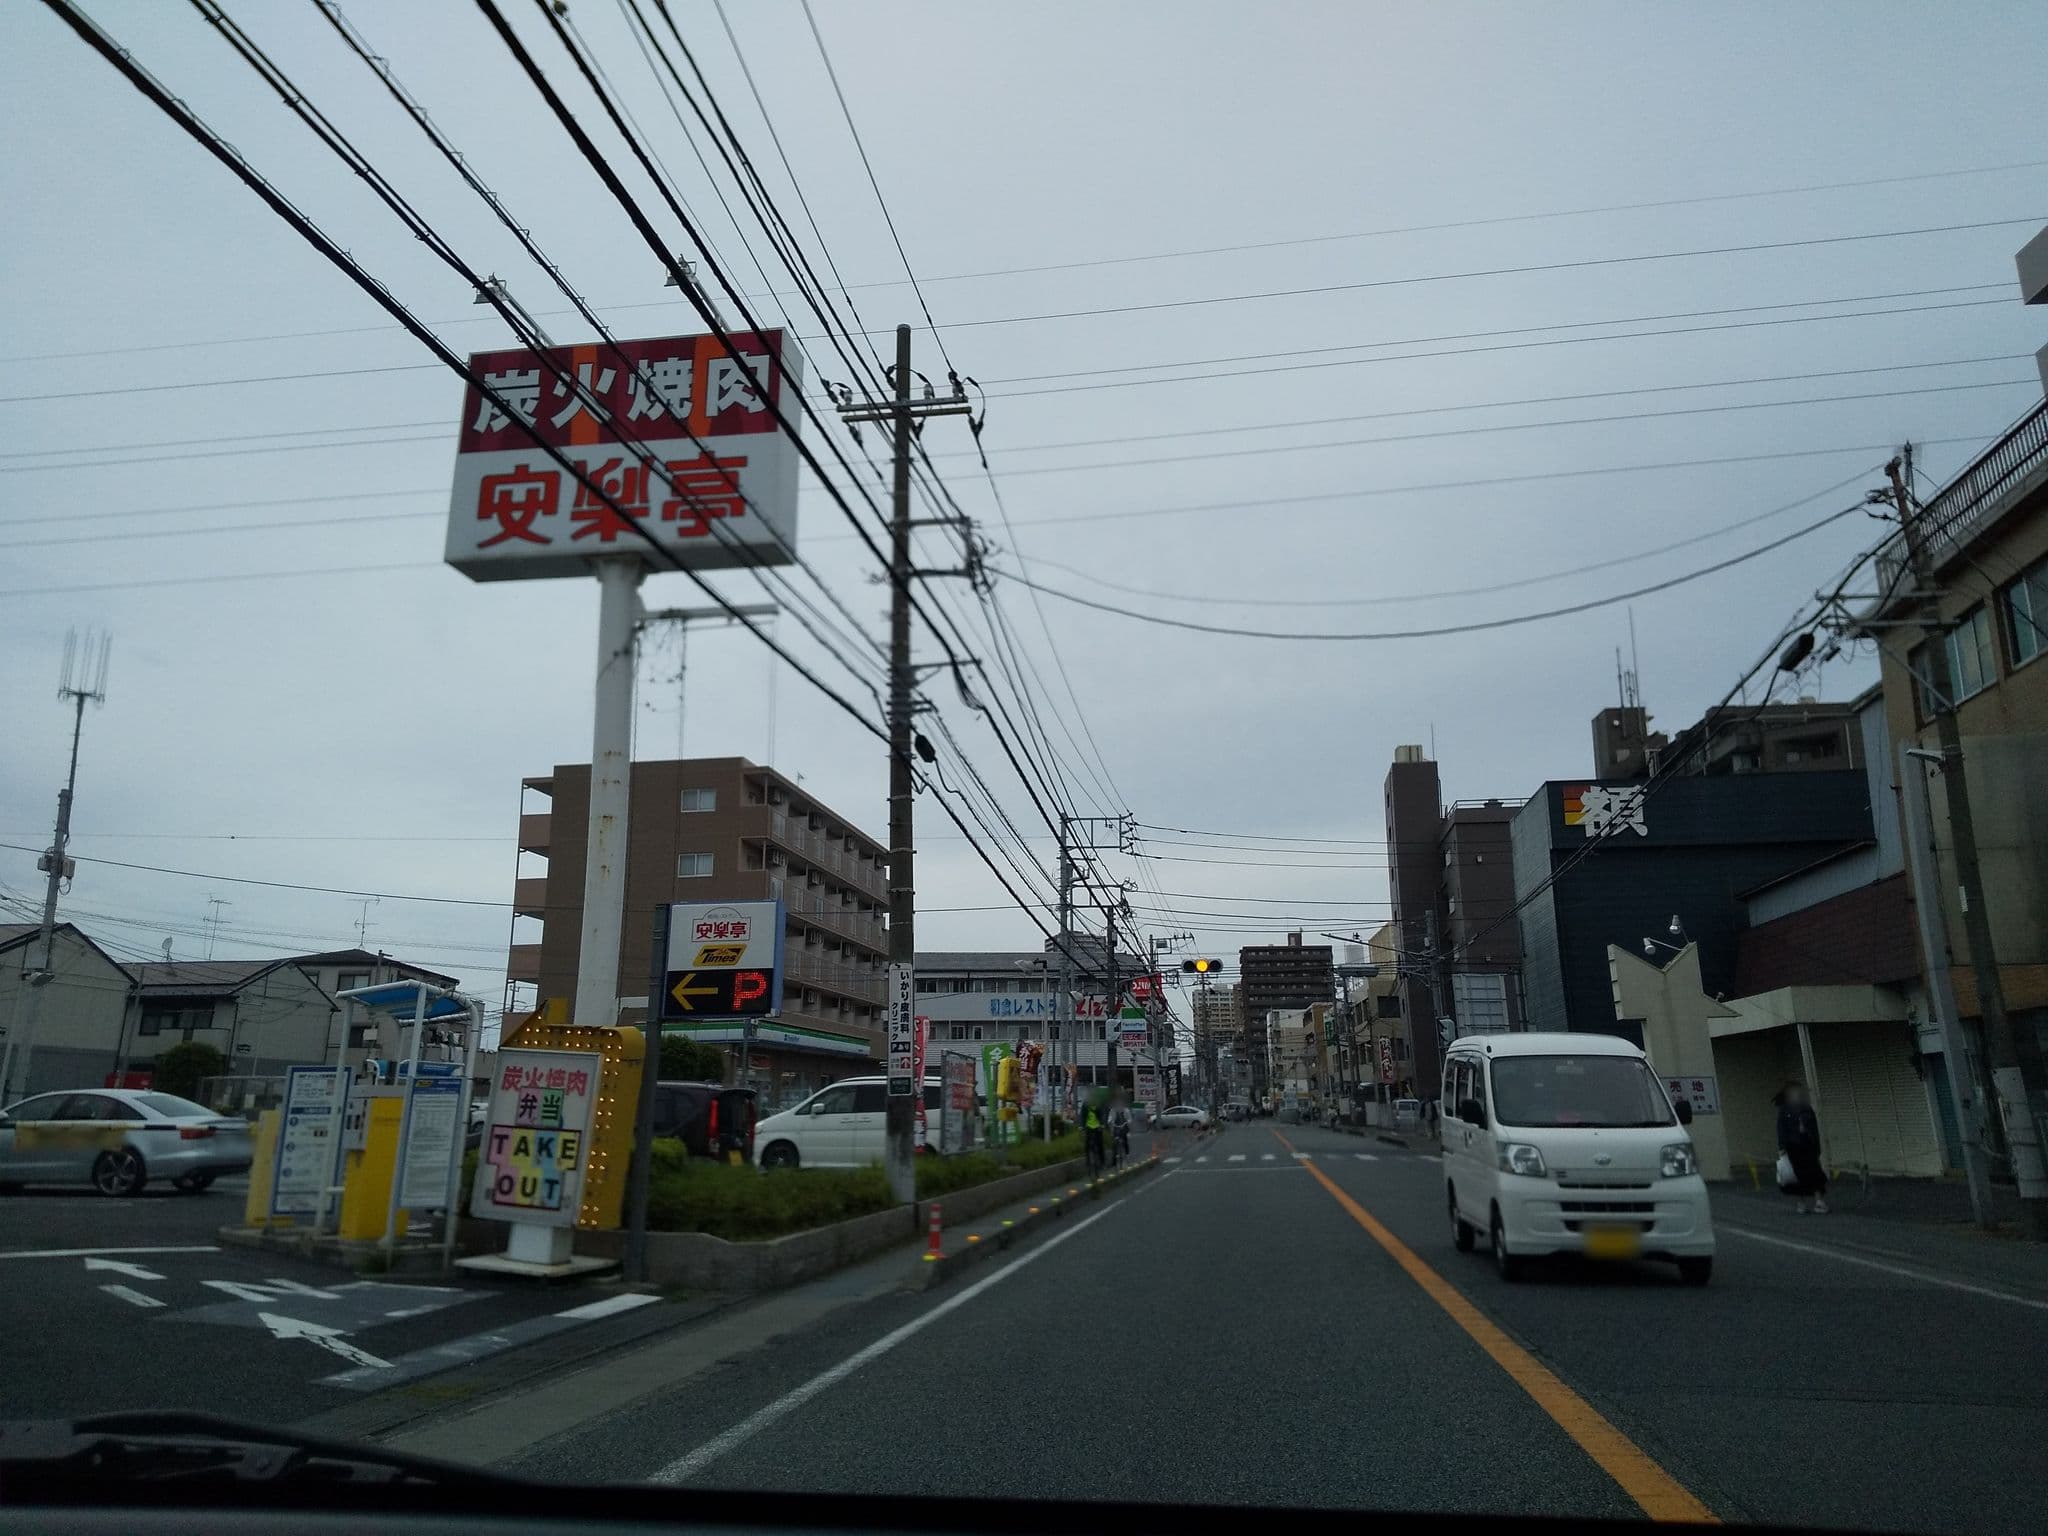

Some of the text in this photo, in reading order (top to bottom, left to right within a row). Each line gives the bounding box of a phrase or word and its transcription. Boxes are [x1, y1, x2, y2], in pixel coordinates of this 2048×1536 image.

[472, 350, 771, 433] 炭火焼肉
[699, 949, 738, 964] Times
[732, 971, 768, 1011] P
[900, 971, 910, 1033] いかり皮膚科
[519, 1092, 561, 1120] 弁当
[493, 1133, 577, 1160] TAKE
[498, 1175, 560, 1200] OUT
